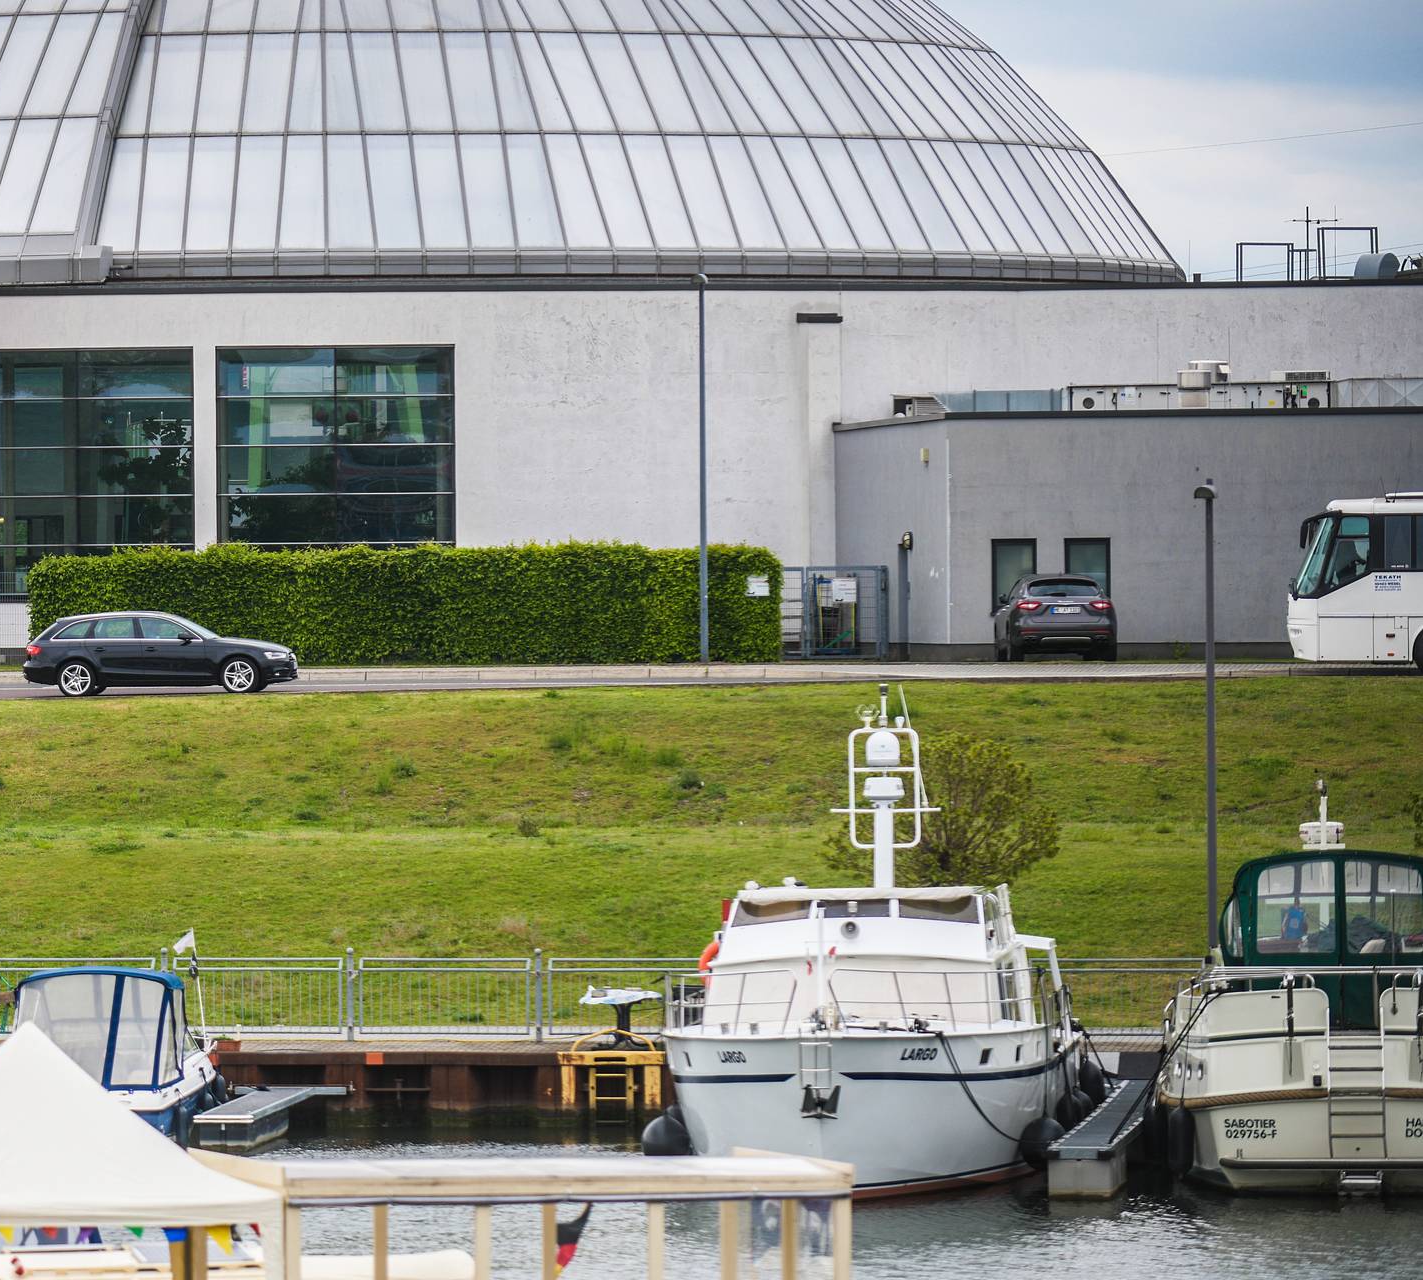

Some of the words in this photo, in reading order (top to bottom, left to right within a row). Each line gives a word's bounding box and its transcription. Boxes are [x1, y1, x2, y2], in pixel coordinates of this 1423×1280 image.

[717, 1050, 746, 1063] LARGO
[900, 1047, 938, 1061] LARGO
[1224, 1118, 1276, 1128] SABOTIER
[1225, 1129, 1278, 1139] 029756-F
